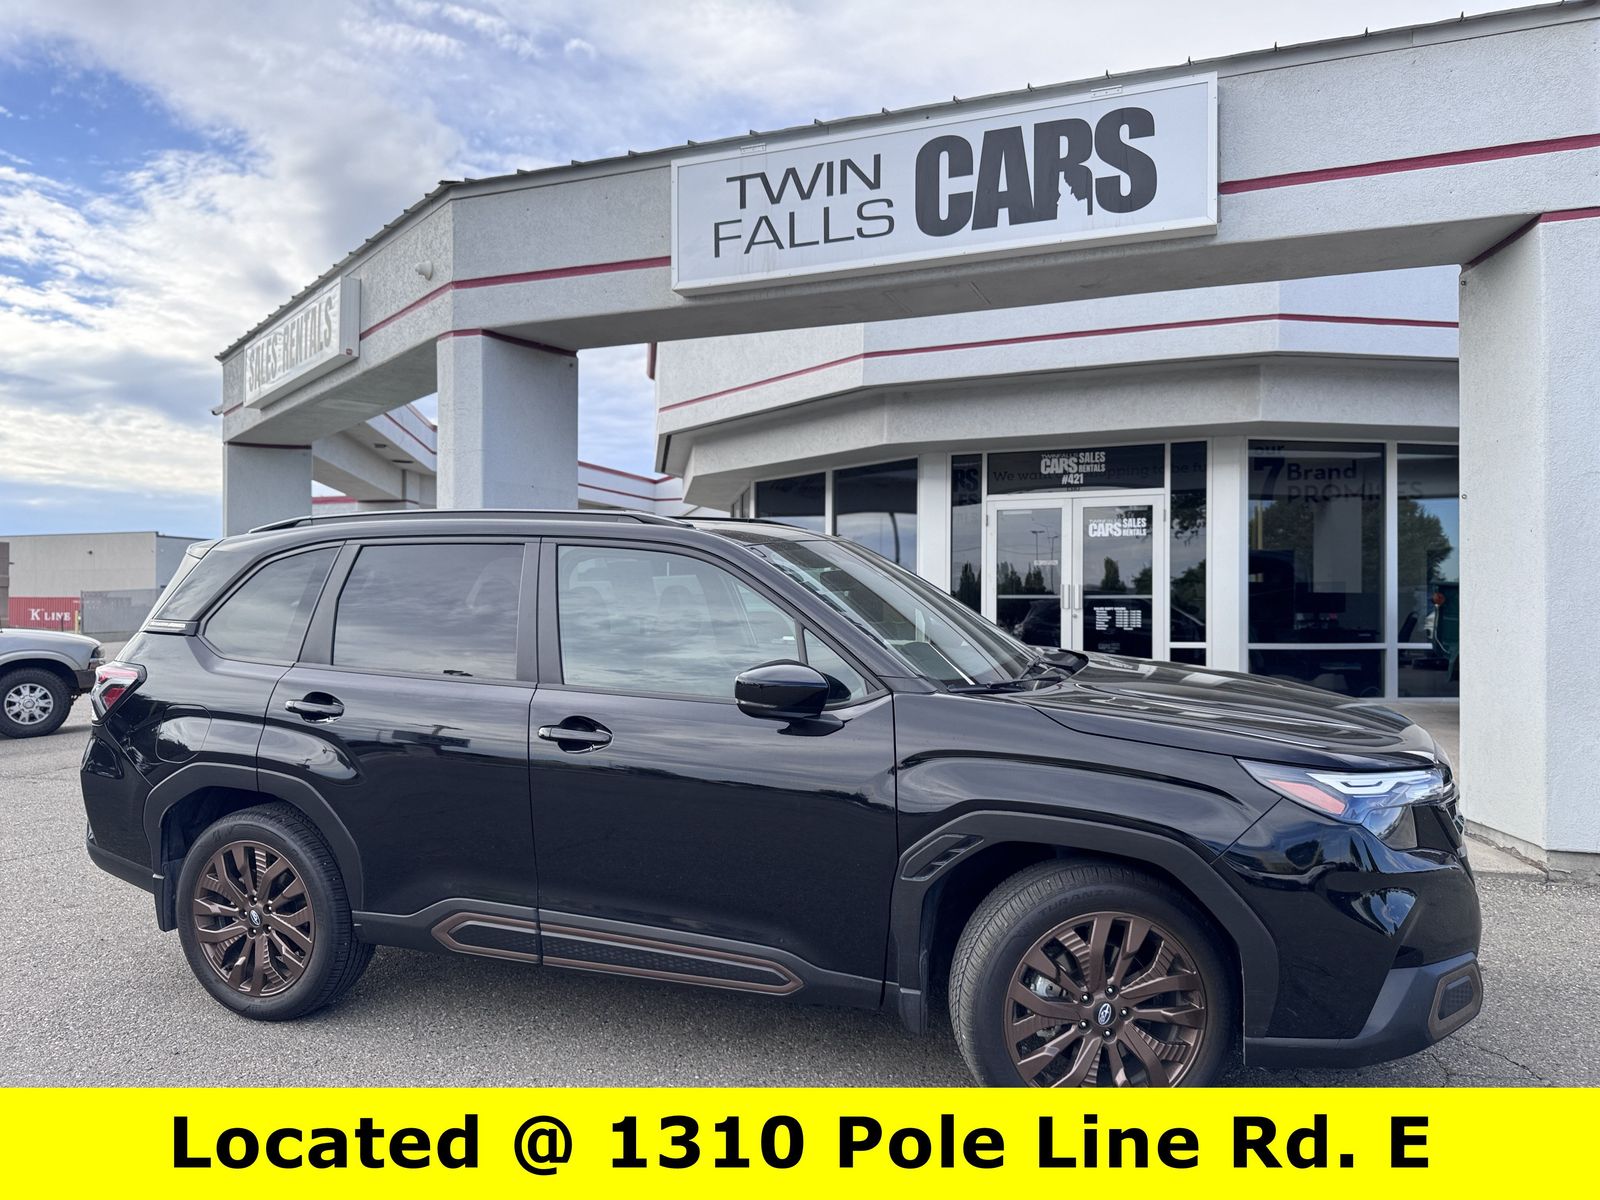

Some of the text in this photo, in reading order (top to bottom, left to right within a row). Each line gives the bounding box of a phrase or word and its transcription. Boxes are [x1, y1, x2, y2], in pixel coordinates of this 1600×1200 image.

[915, 106, 1158, 237] CARS
[726, 153, 882, 210] TWIN
[713, 197, 895, 259] FALLS
[248, 296, 335, 392] SALES RENTALS
[1040, 457, 1078, 474] CARS
[1078, 452, 1106, 463] SALES
[1078, 464, 1106, 473] RENTALS
[1287, 459, 1357, 481] Brand
[1061, 473, 1084, 485] #421
[1254, 457, 1285, 500] 7
[1088, 522, 1122, 537] CARS
[1122, 517, 1147, 528] SALES
[1122, 528, 1147, 537] RENTALS
[44, 611, 71, 621] LINE
